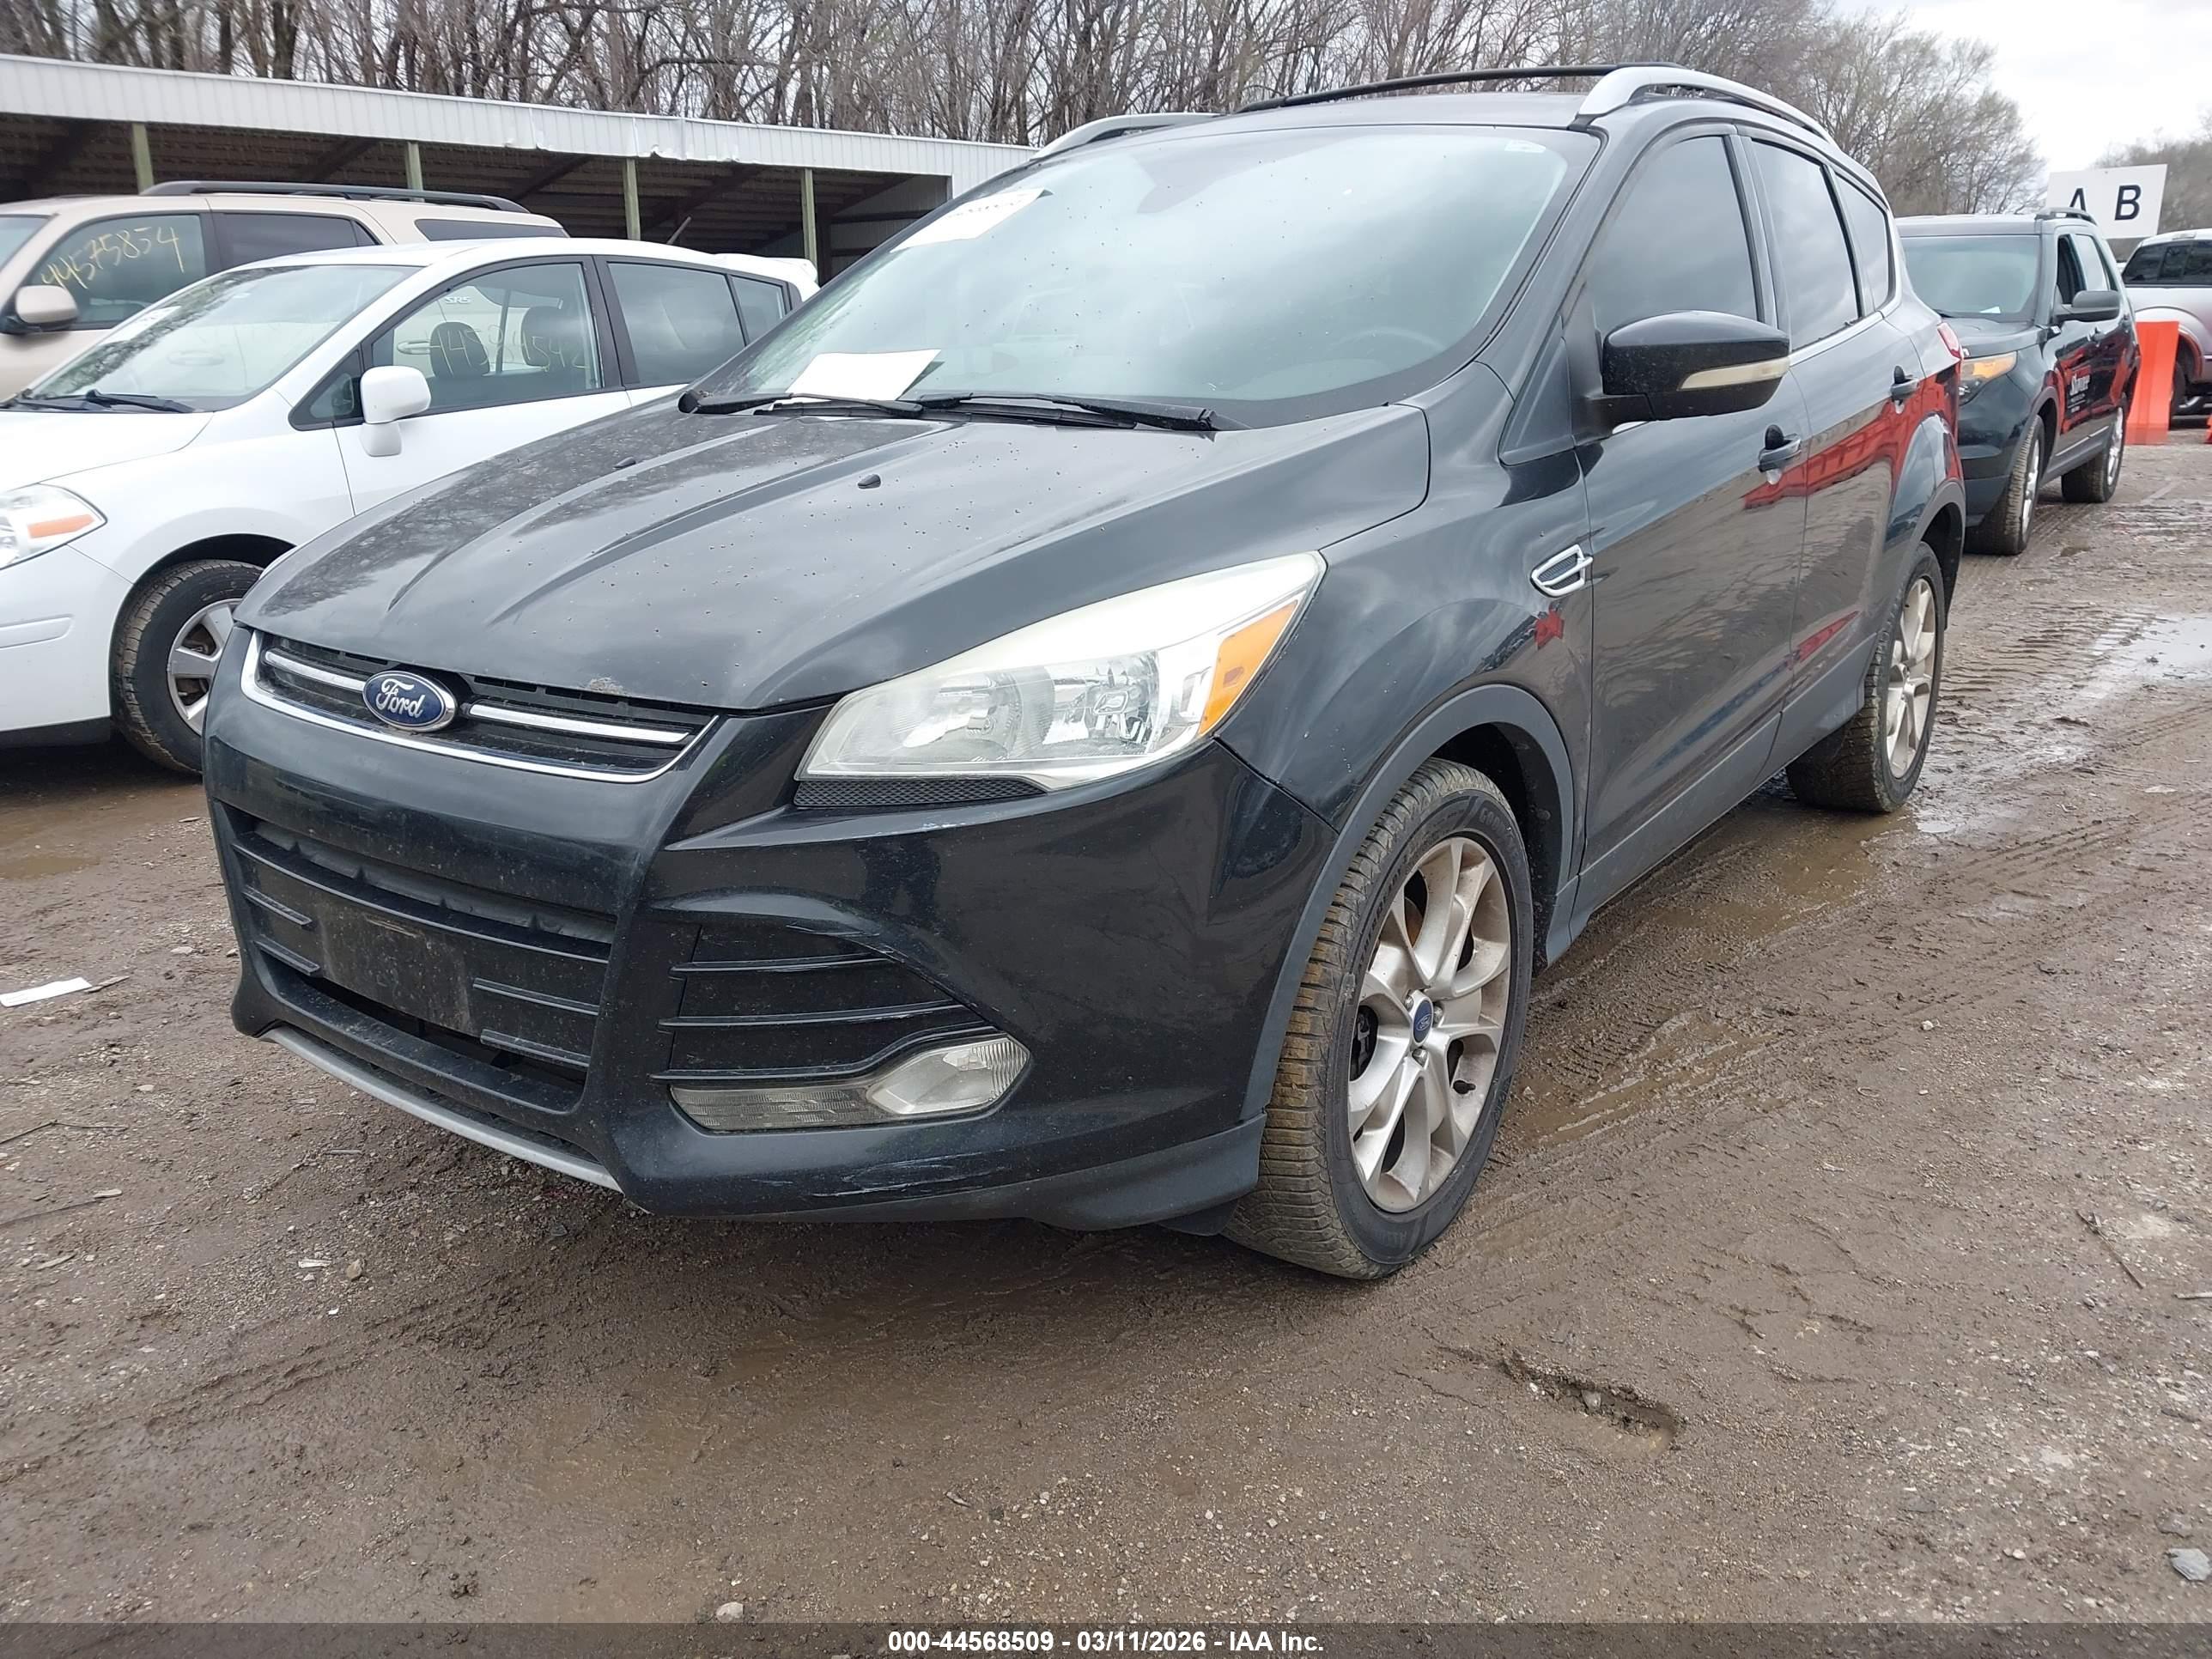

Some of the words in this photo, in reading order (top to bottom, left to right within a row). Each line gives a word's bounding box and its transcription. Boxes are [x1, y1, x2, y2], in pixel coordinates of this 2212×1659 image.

[2114, 184, 2142, 221] B
[40, 226, 185, 289] 44575854
[375, 678, 426, 719] Ford
